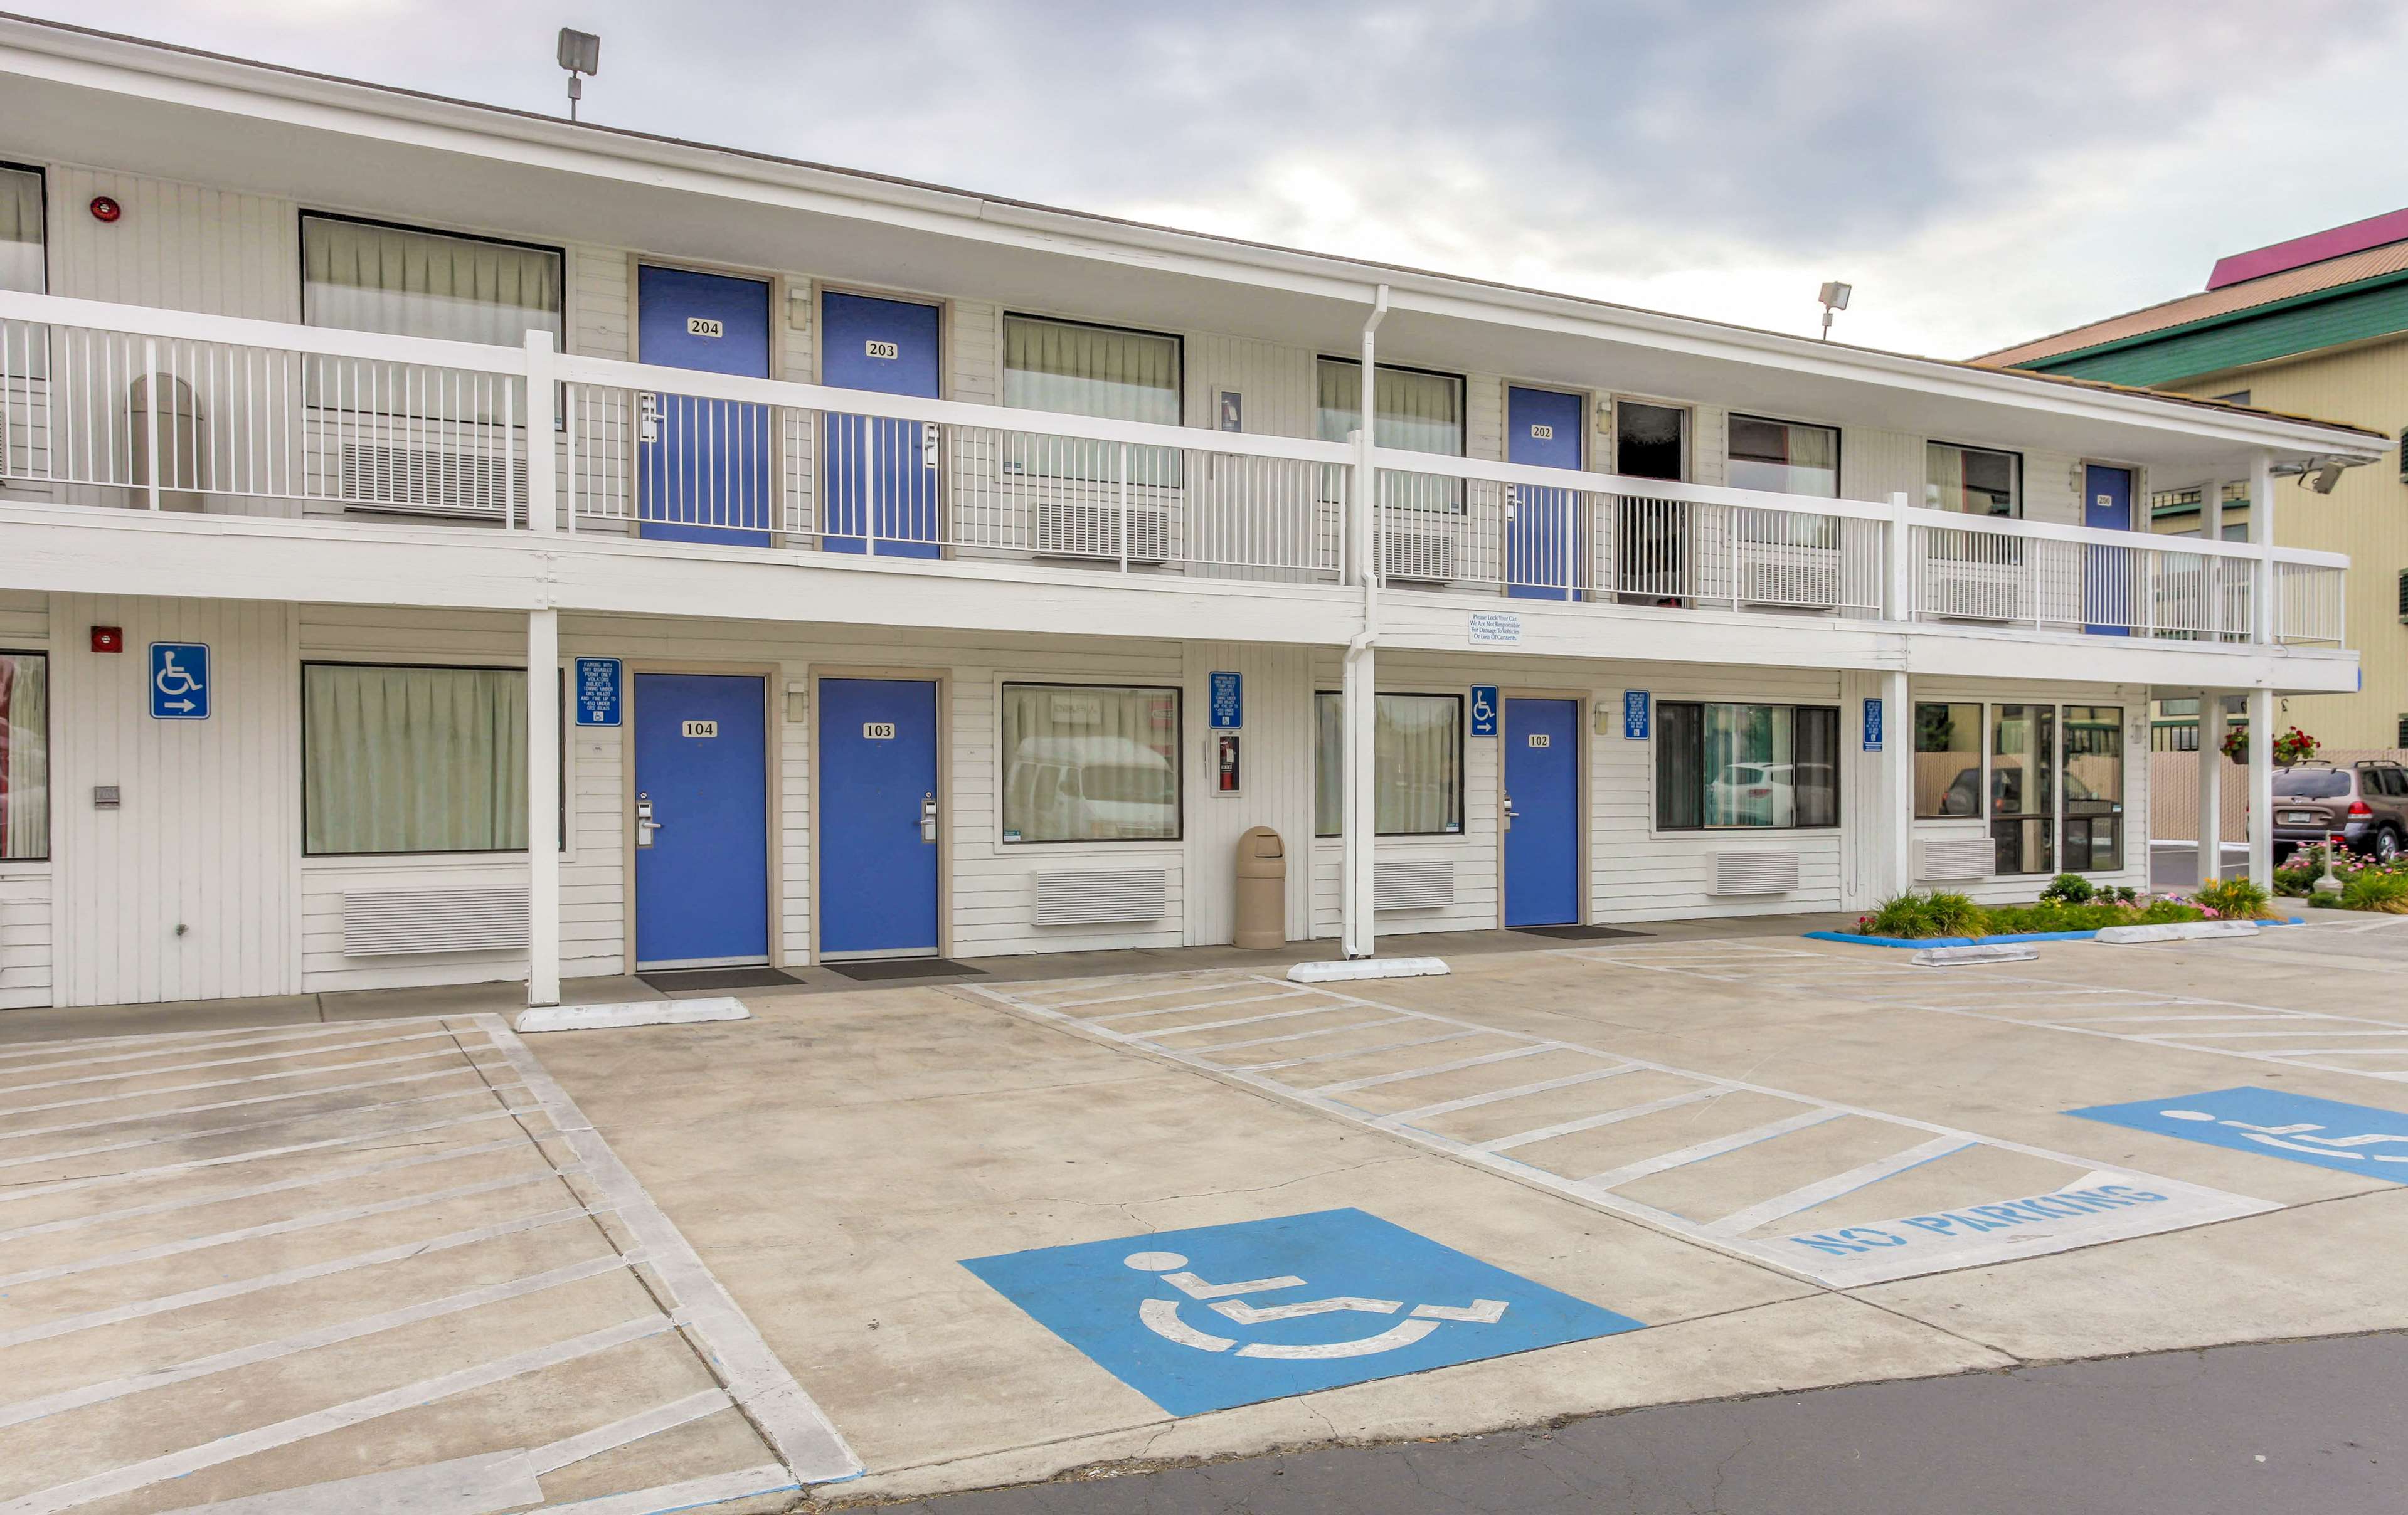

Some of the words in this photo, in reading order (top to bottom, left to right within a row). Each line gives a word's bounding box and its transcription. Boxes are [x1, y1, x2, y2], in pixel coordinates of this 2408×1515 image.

[692, 320, 719, 335] 204
[870, 343, 894, 356] 203
[1534, 426, 1550, 437] 202
[687, 723, 713, 735] 104
[868, 725, 891, 737] 103
[1532, 736, 1547, 746] 102
[1789, 1228, 1907, 1255] NO
[1900, 1185, 2168, 1236] PARKING
